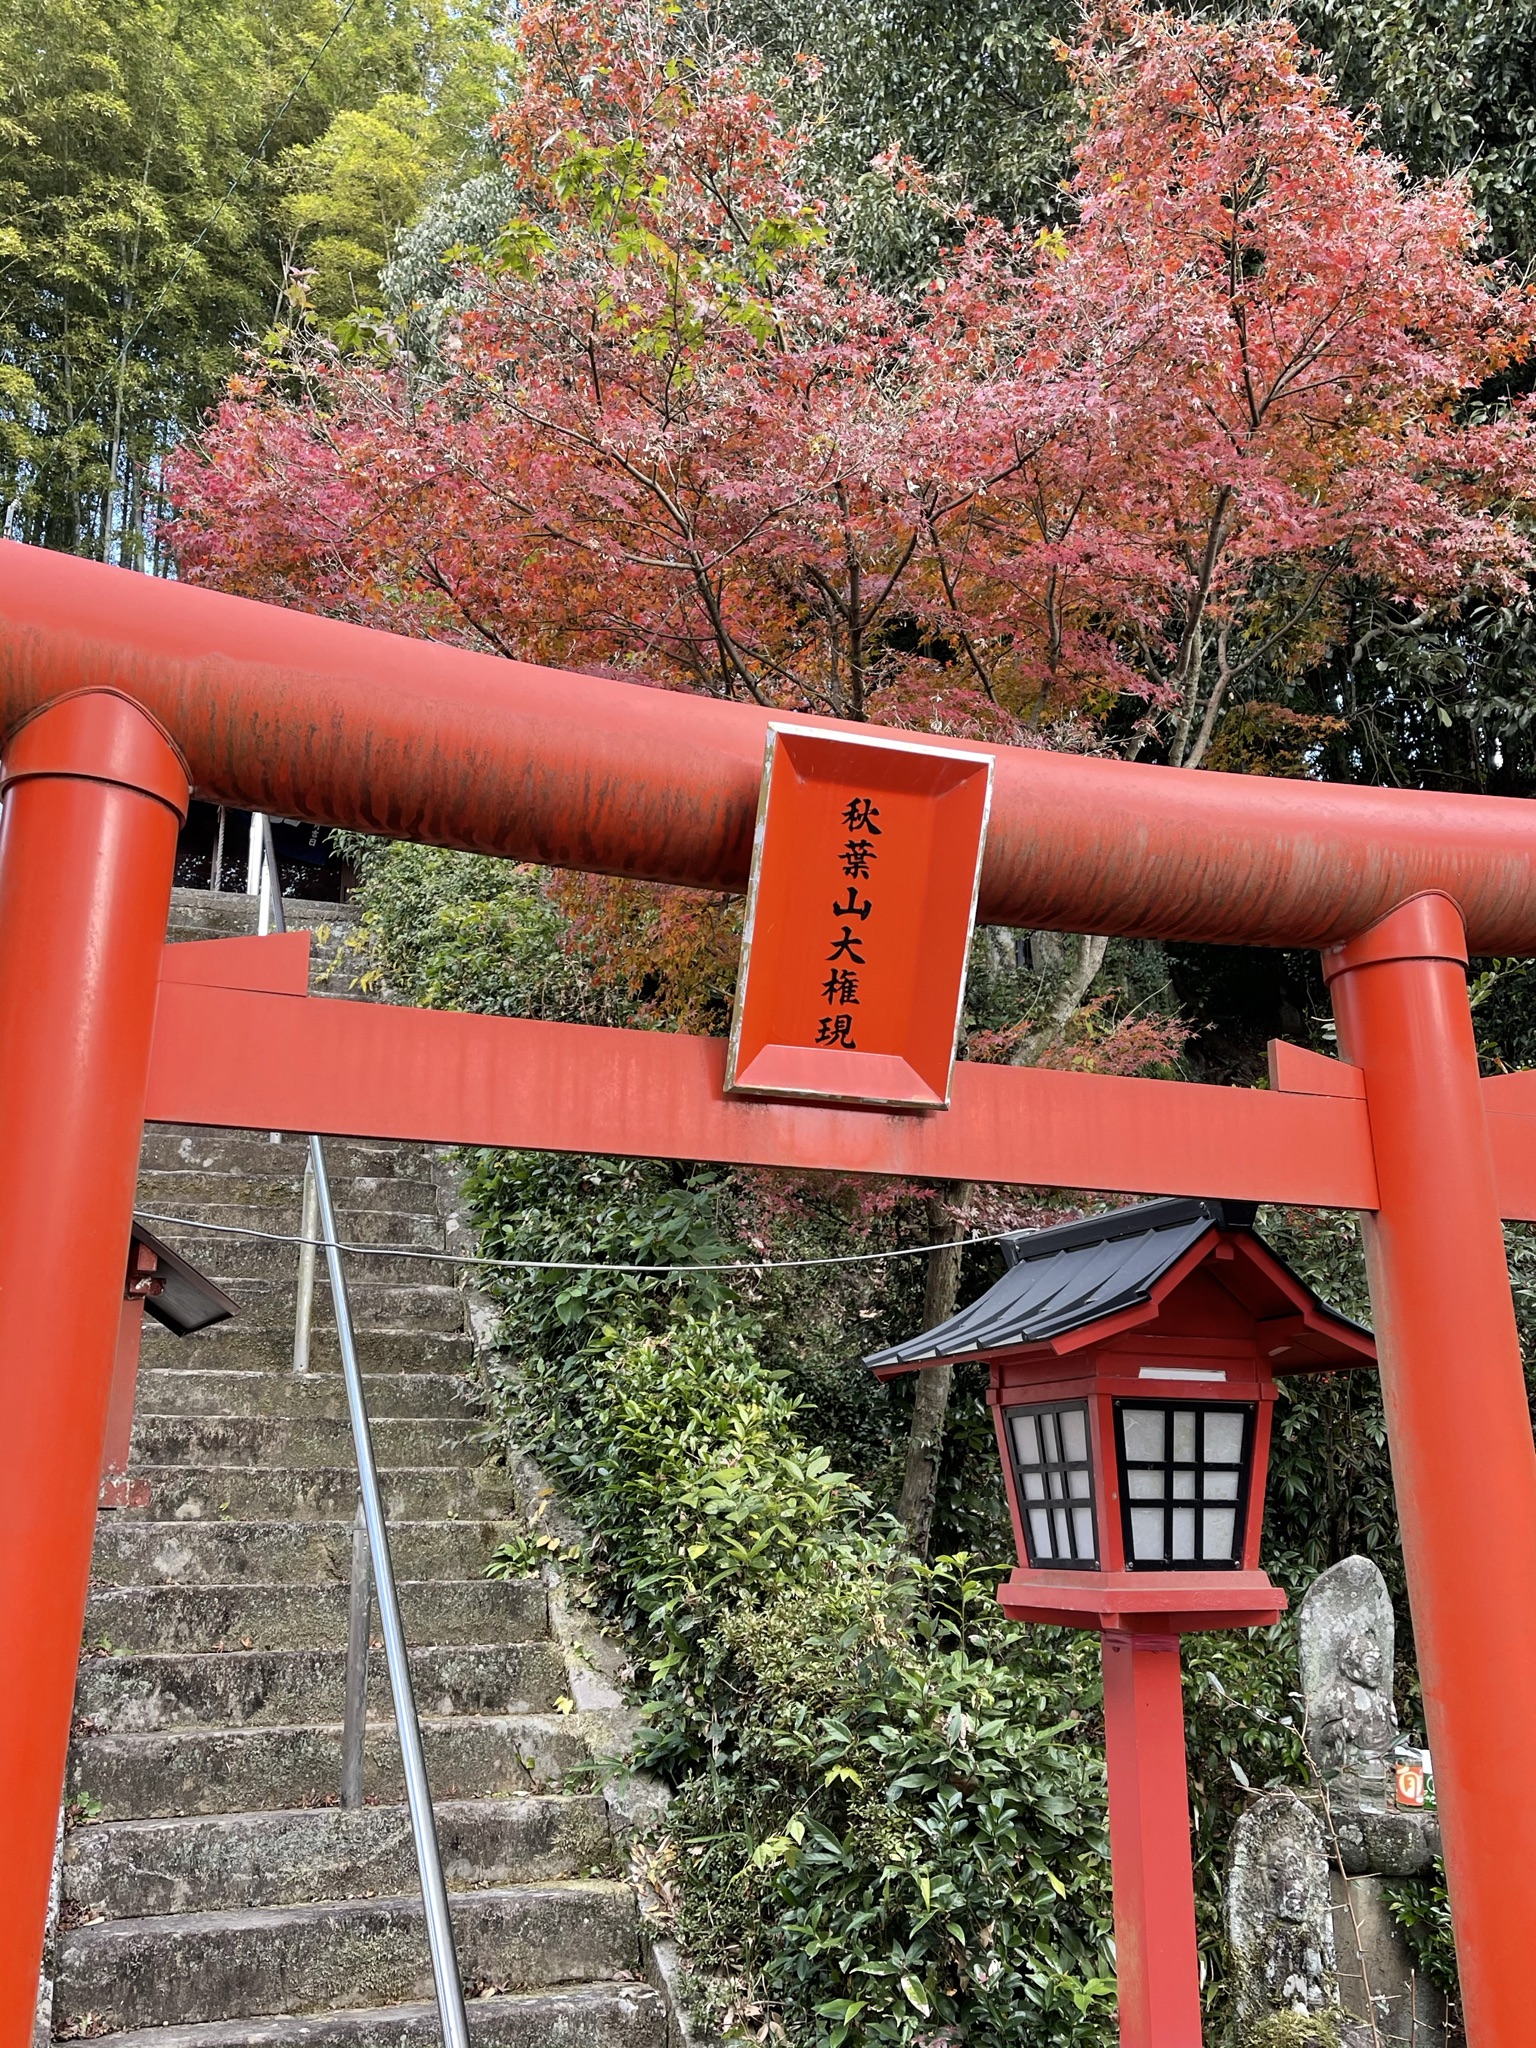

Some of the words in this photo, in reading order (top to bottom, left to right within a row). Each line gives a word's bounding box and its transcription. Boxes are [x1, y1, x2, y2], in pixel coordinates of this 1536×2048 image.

[815, 797, 882, 1049] 秋葉山大権現
